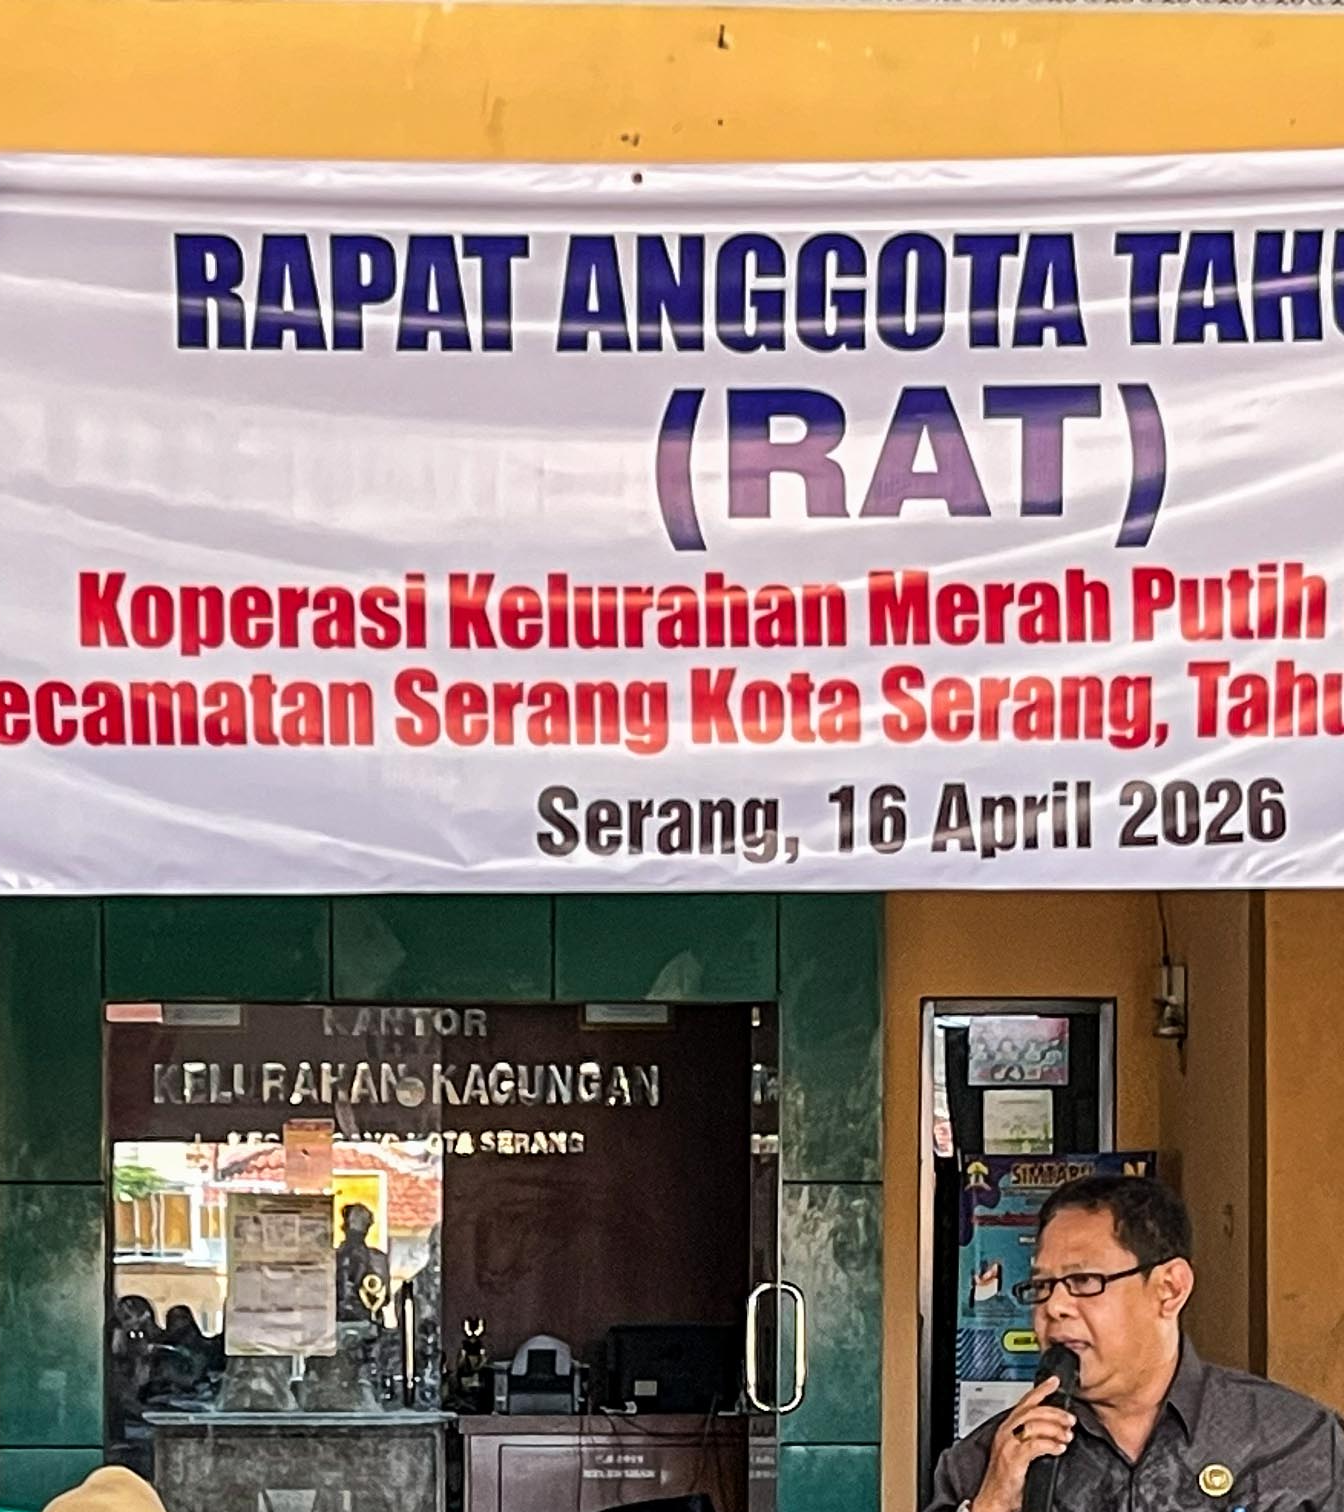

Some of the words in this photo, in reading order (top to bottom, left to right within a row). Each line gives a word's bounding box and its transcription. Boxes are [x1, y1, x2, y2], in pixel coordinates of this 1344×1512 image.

[175, 233, 529, 351] RAPAT
[556, 230, 1087, 353] ANGGOTA
[656, 382, 1167, 551] (RAT)
[78, 572, 427, 657] Koperasi
[448, 570, 848, 651] Kelurahan
[868, 568, 1111, 646] Merah
[1131, 563, 1328, 641] Putih
[393, 666, 669, 755] Serang
[689, 667, 862, 746] Kota
[881, 664, 1169, 751] Serang,
[536, 784, 800, 865] Serang,
[828, 784, 907, 854] 16
[931, 780, 1092, 859] April
[1118, 776, 1287, 847] 2026
[323, 1006, 487, 1037] KANTOR
[153, 1061, 413, 1106] KELURAHAN
[433, 1061, 659, 1107] KAGUNGAN
[480, 1130, 585, 1156] SERANG
